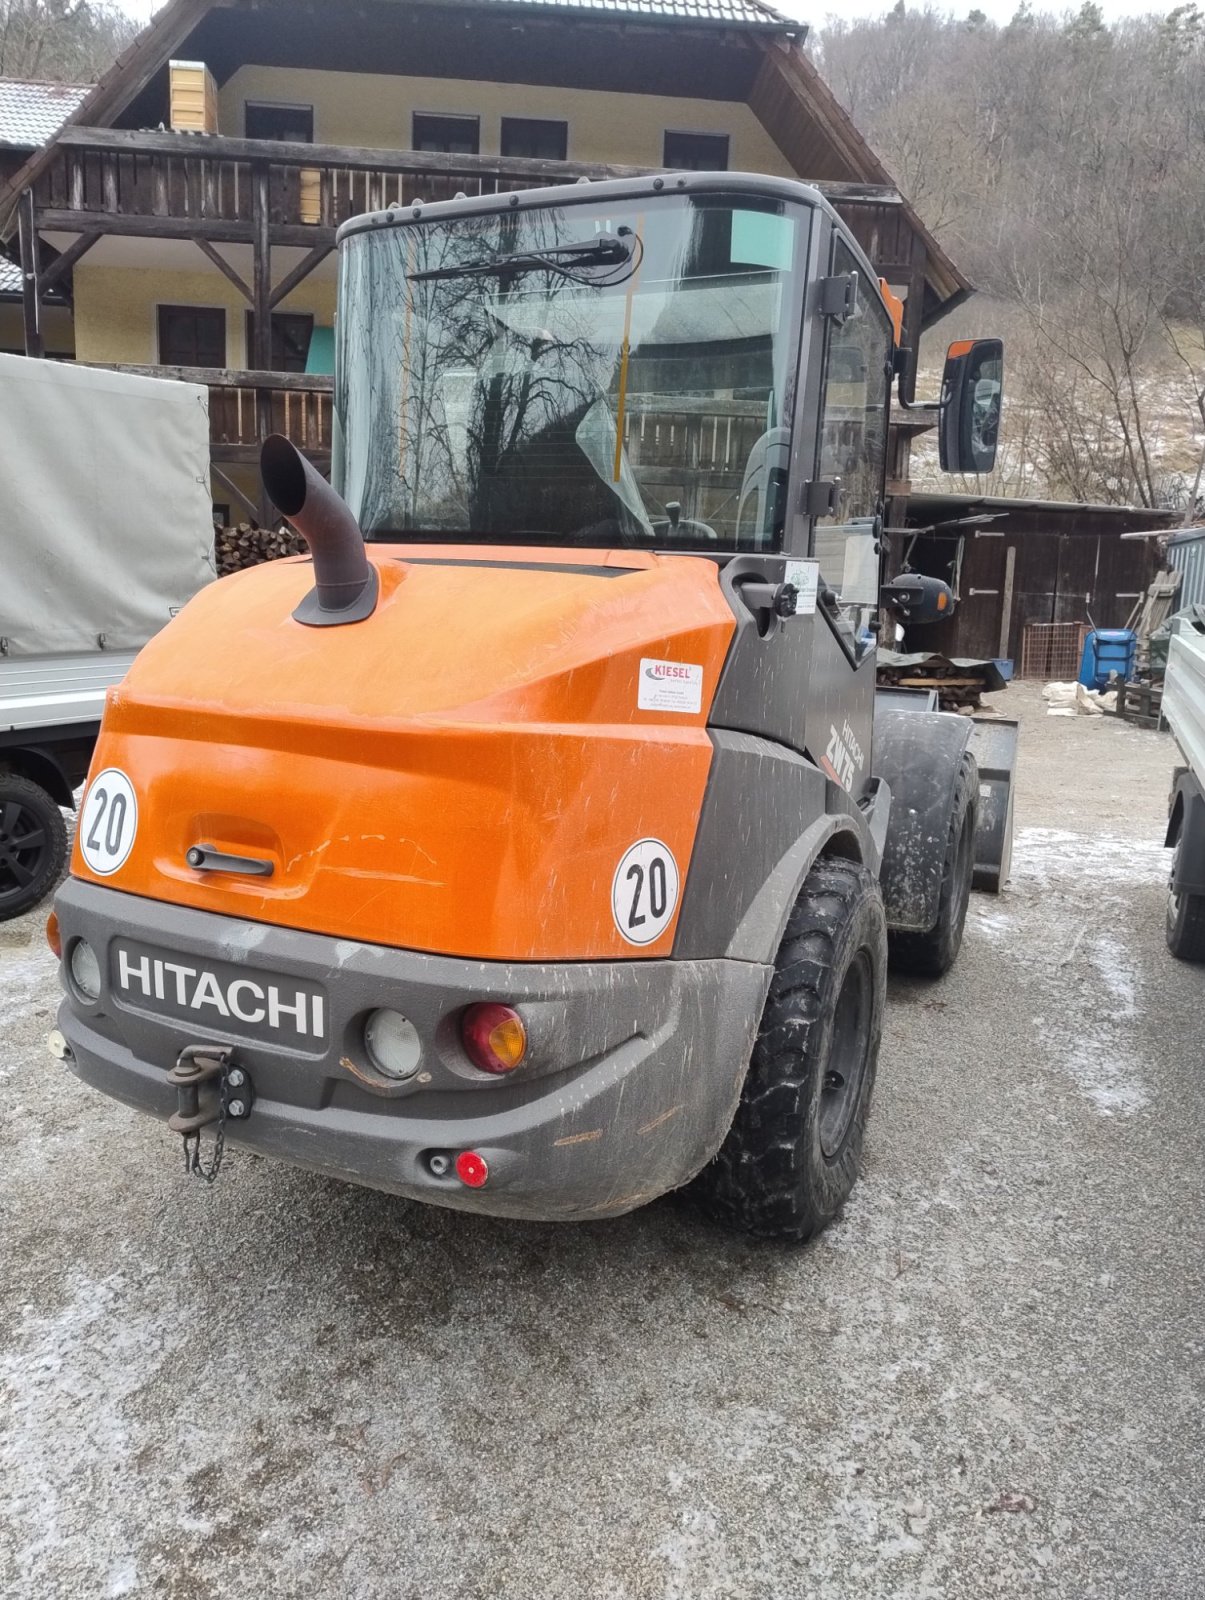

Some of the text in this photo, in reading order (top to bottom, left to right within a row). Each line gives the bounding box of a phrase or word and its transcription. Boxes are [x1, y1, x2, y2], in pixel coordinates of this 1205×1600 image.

[655, 664, 691, 679] KIESEL
[825, 723, 856, 793] ZW75
[842, 719, 865, 771] HITACHI
[86, 787, 127, 856] 20
[626, 857, 667, 928] 20
[118, 949, 324, 1038] HITACHI
